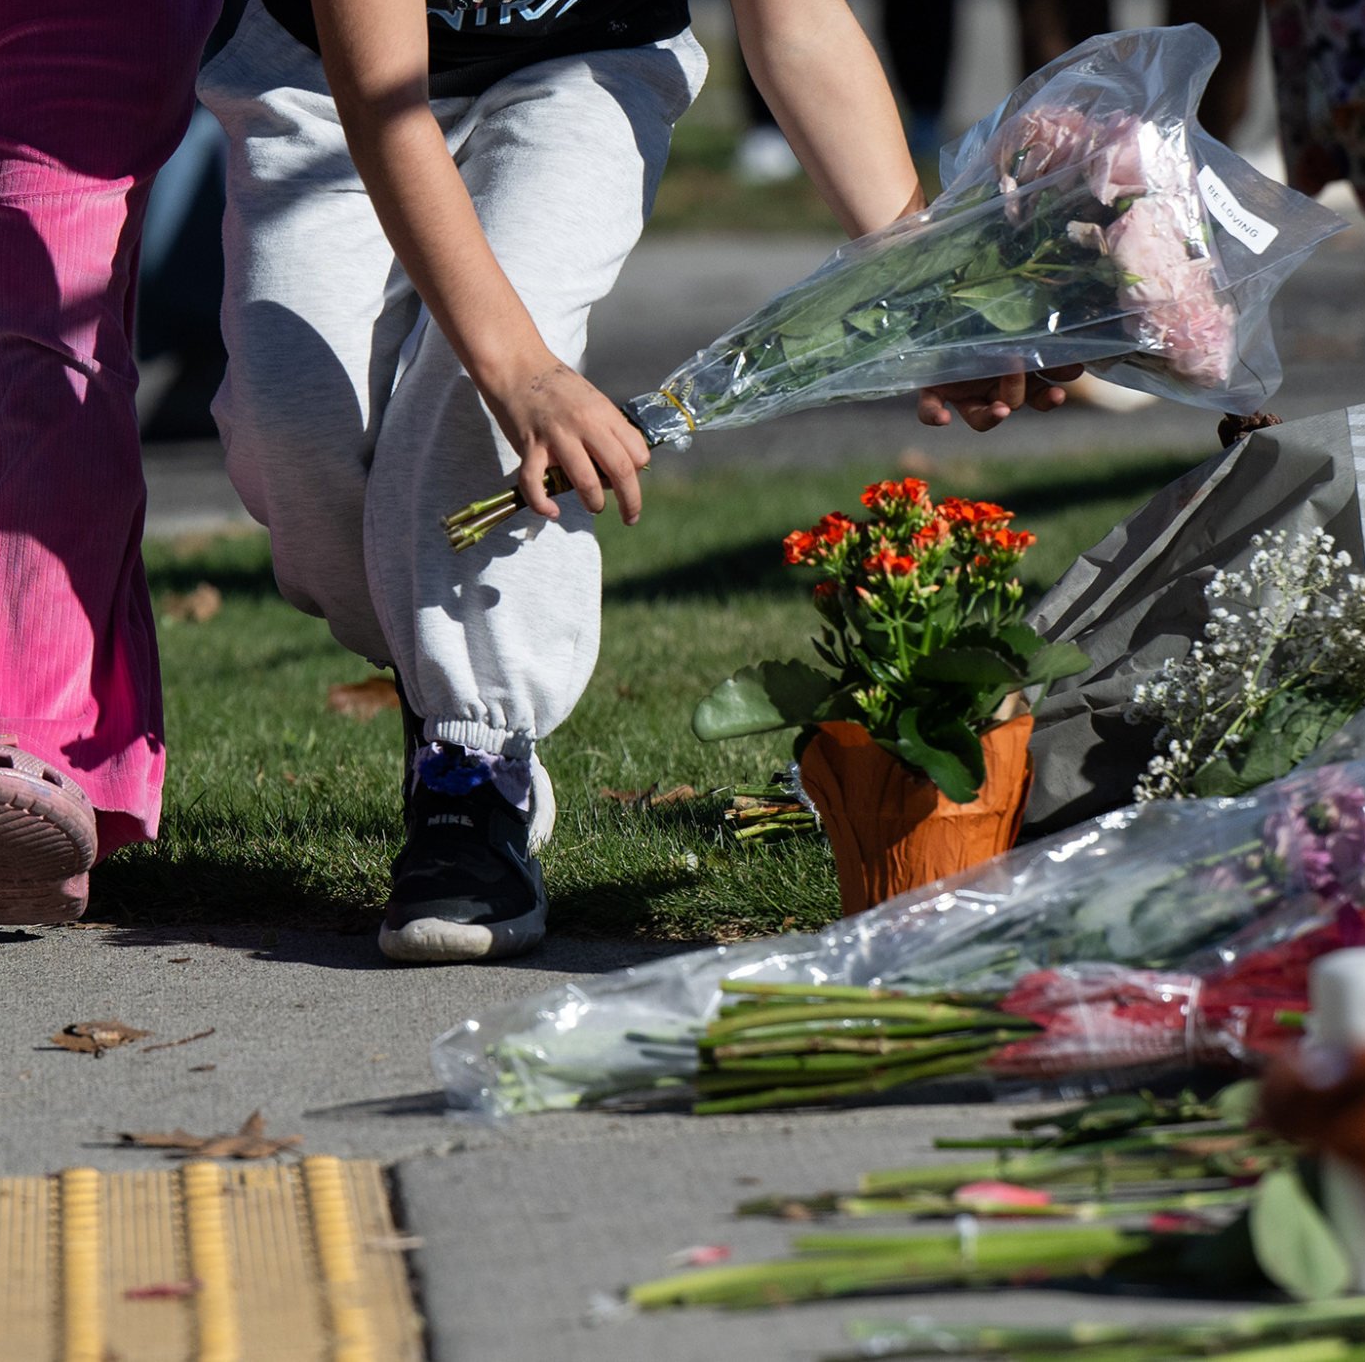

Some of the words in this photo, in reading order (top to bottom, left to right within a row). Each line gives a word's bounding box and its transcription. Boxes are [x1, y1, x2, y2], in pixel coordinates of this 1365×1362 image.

[1207, 184, 1220, 200] BE
[1220, 201, 1259, 238] LOVING
[427, 813, 475, 828] NIKE
